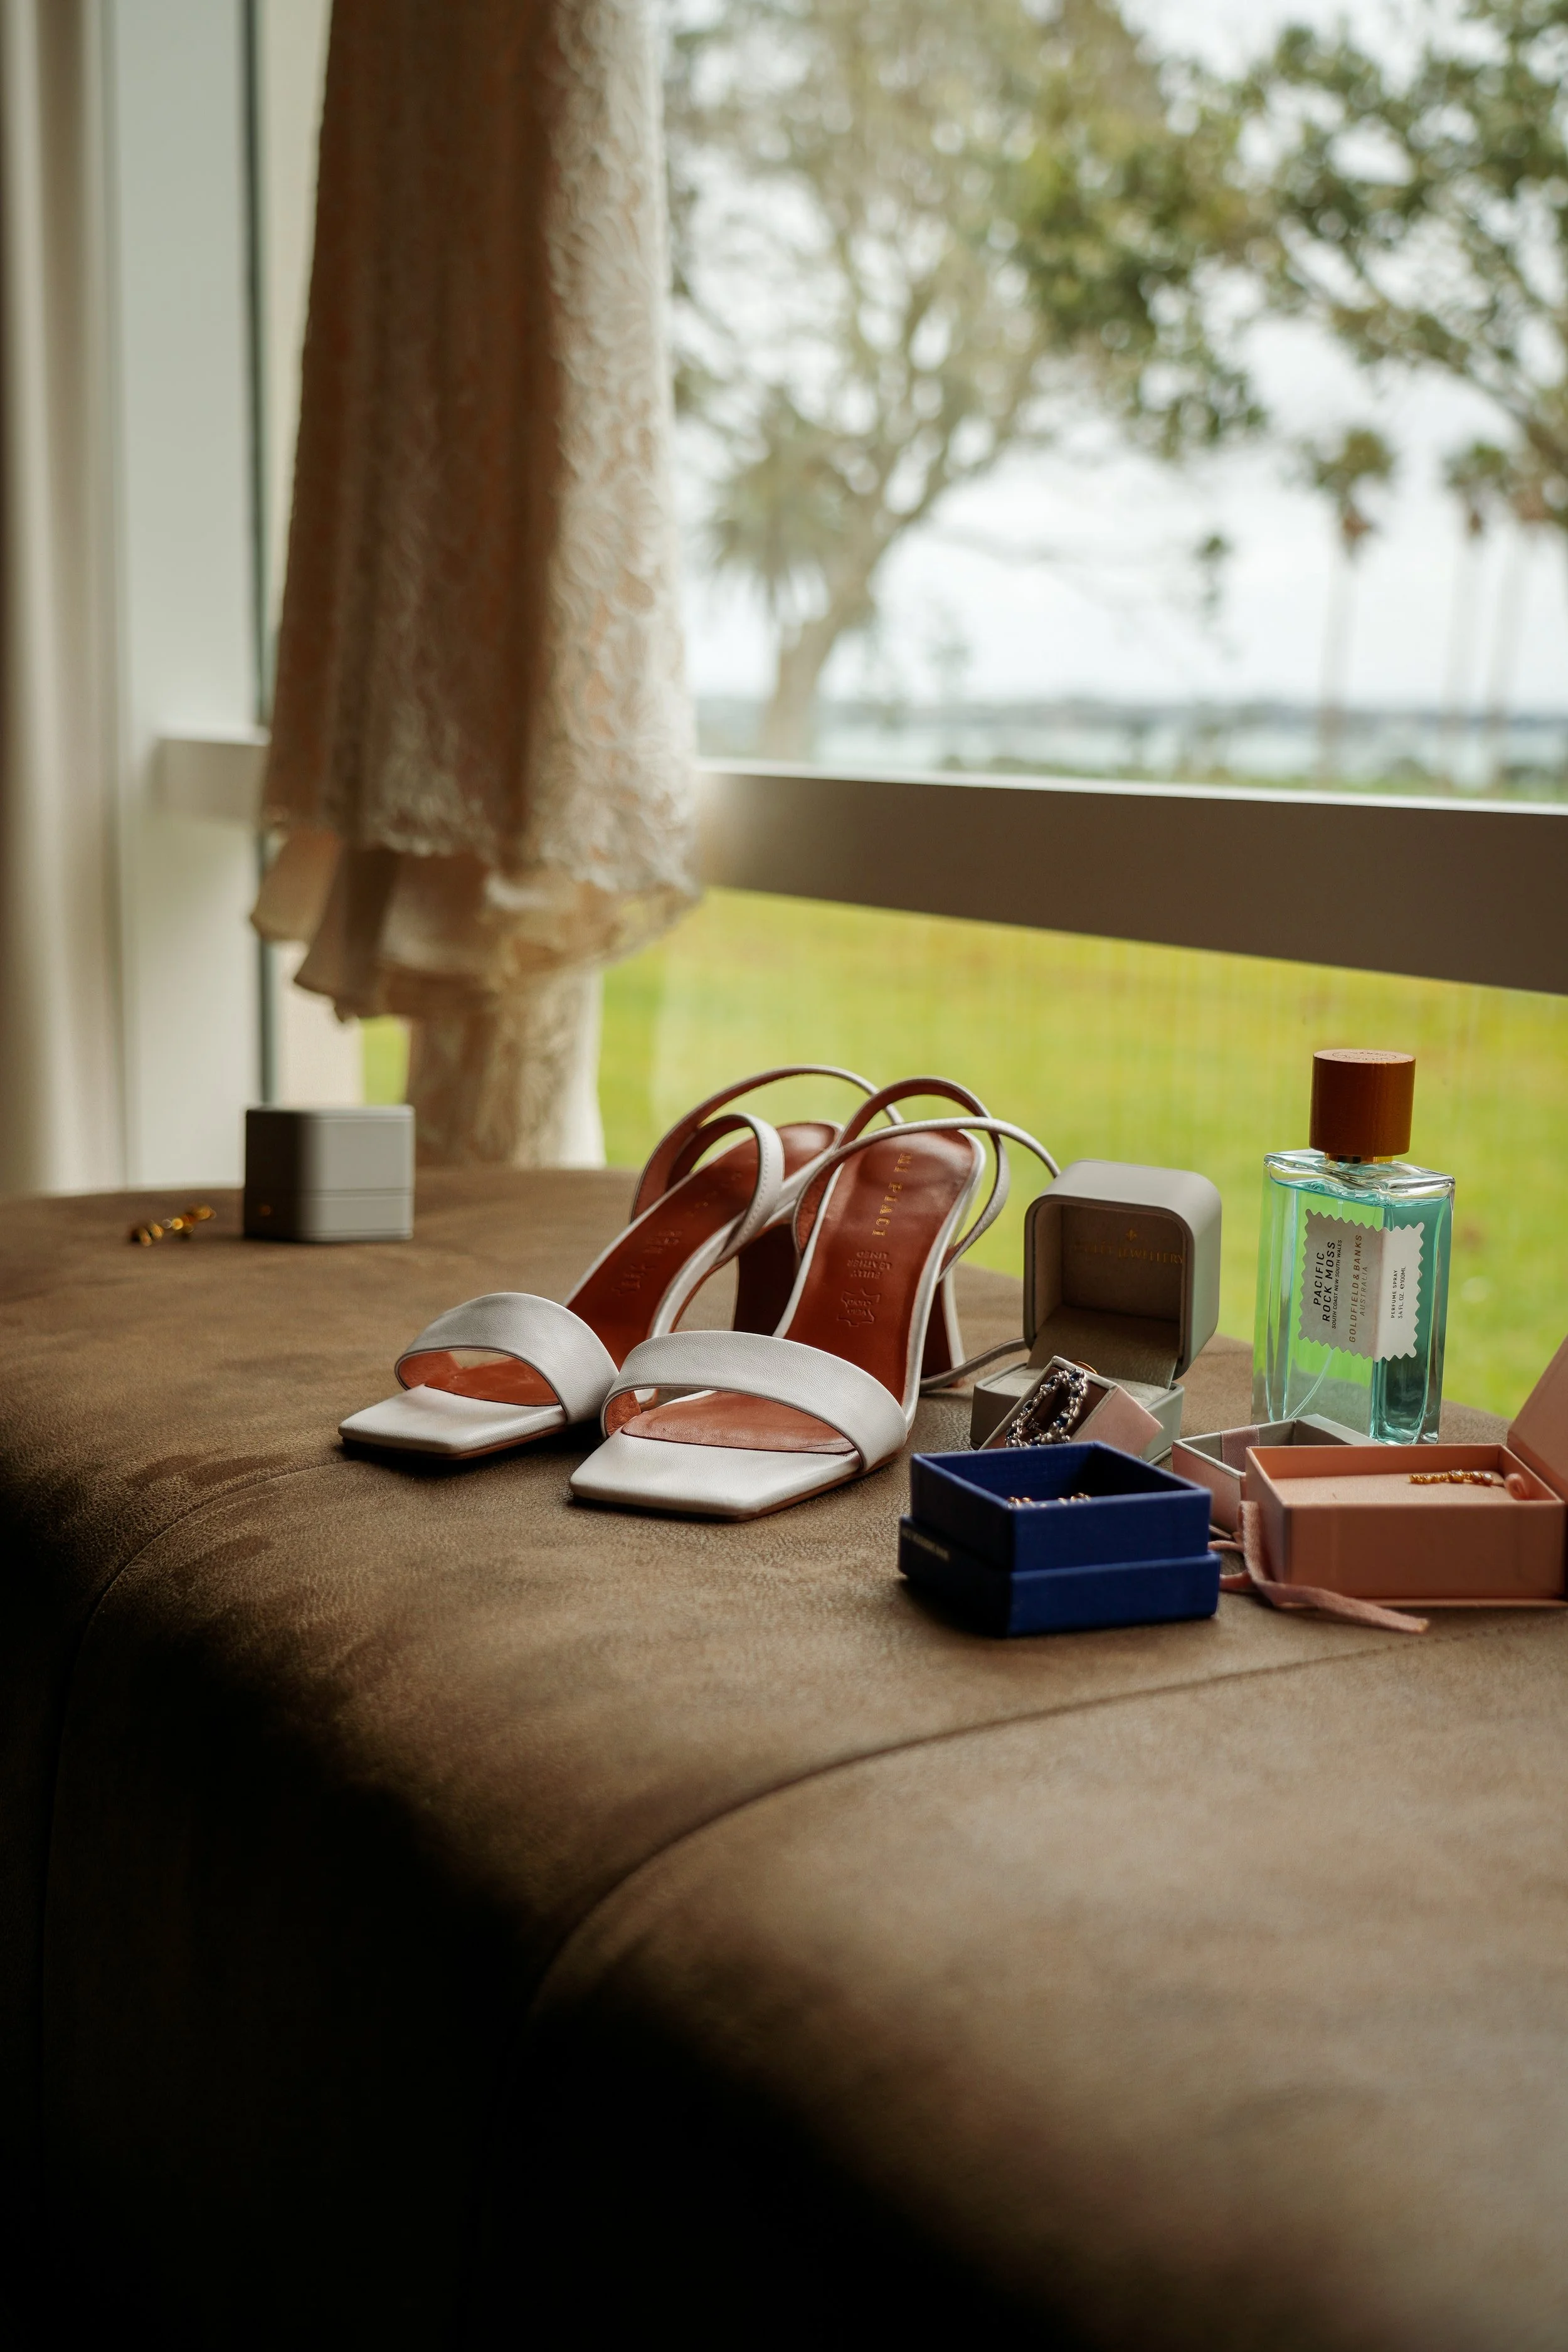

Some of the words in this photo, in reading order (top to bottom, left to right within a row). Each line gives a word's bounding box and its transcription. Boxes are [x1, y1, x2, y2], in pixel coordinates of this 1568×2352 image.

[872, 1182, 902, 1236] PIACI
[1325, 1241, 1335, 1279] MOSS
[1353, 1234, 1362, 1271] BANKS
[1313, 1252, 1325, 1306] PACIFIC
[1322, 1286, 1332, 1322] ROCK
[1360, 1266, 1368, 1316] AUSTRALIA
[1348, 1283, 1359, 1343] GOLDFIELD
